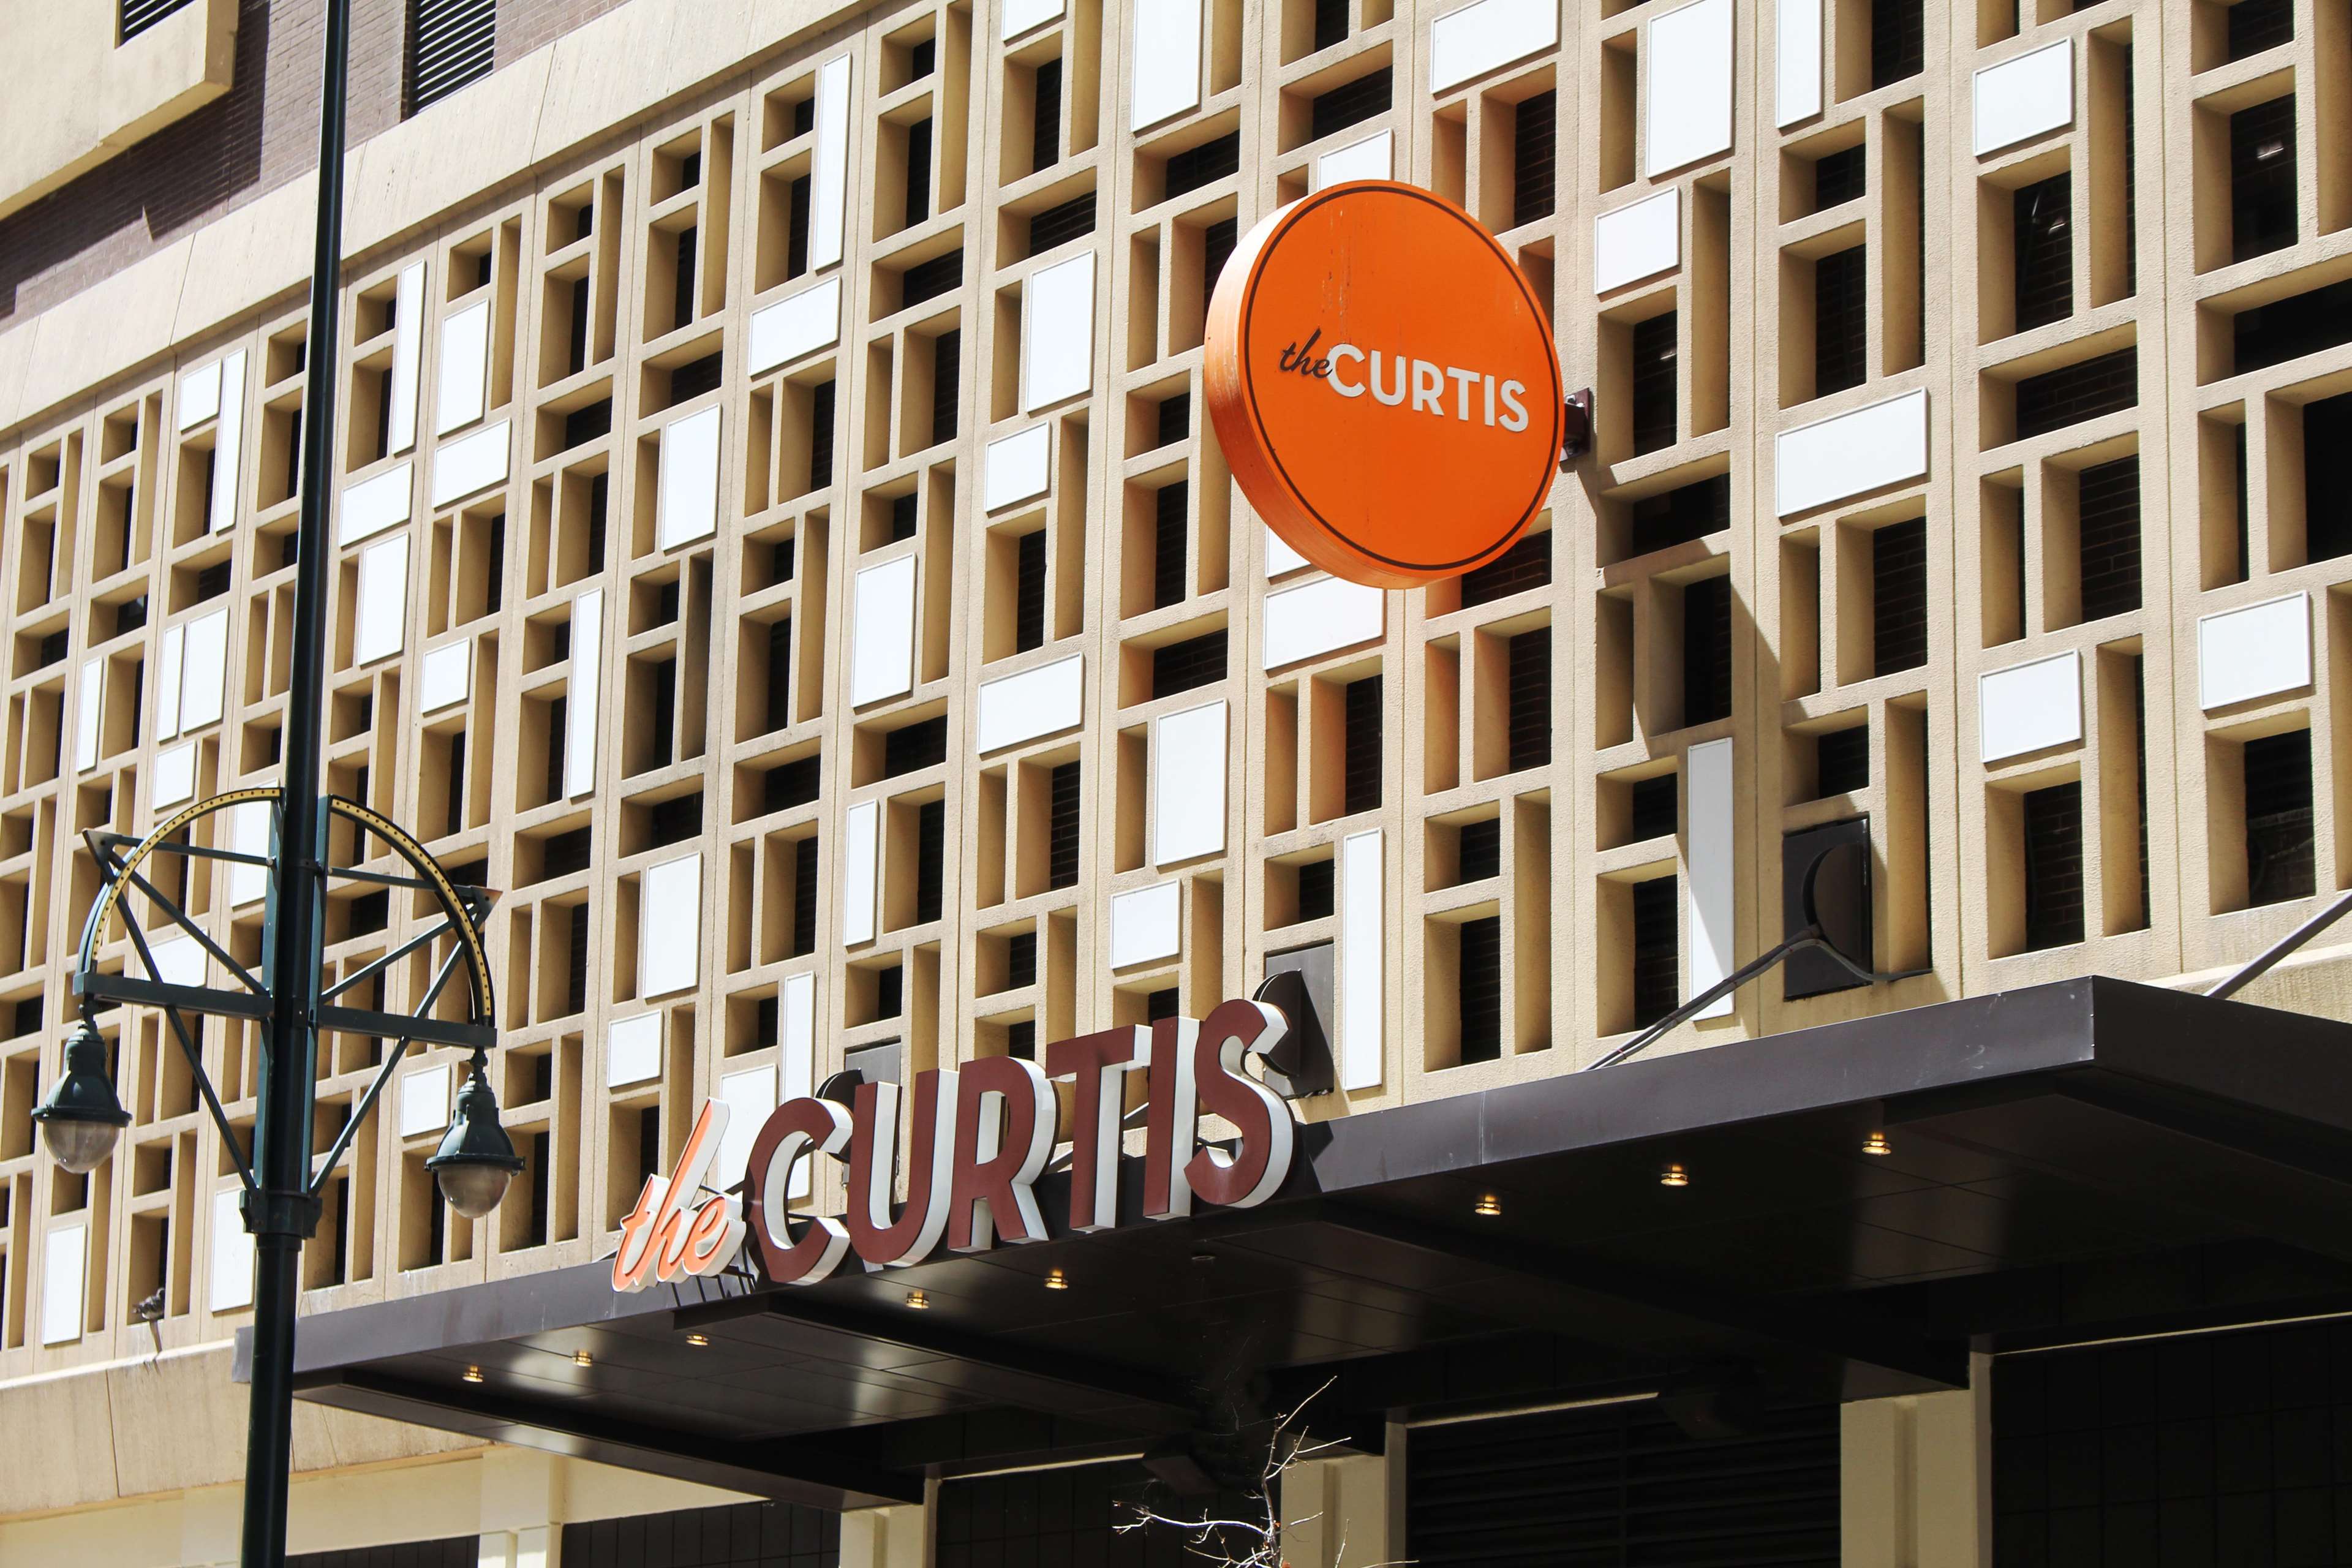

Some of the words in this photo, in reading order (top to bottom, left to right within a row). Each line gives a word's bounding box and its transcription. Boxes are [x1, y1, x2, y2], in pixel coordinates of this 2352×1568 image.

[1278, 327, 1333, 379] the
[1325, 343, 1529, 432] CURTIS
[612, 1096, 746, 1293] the
[744, 998, 1295, 1286] CURTIS
